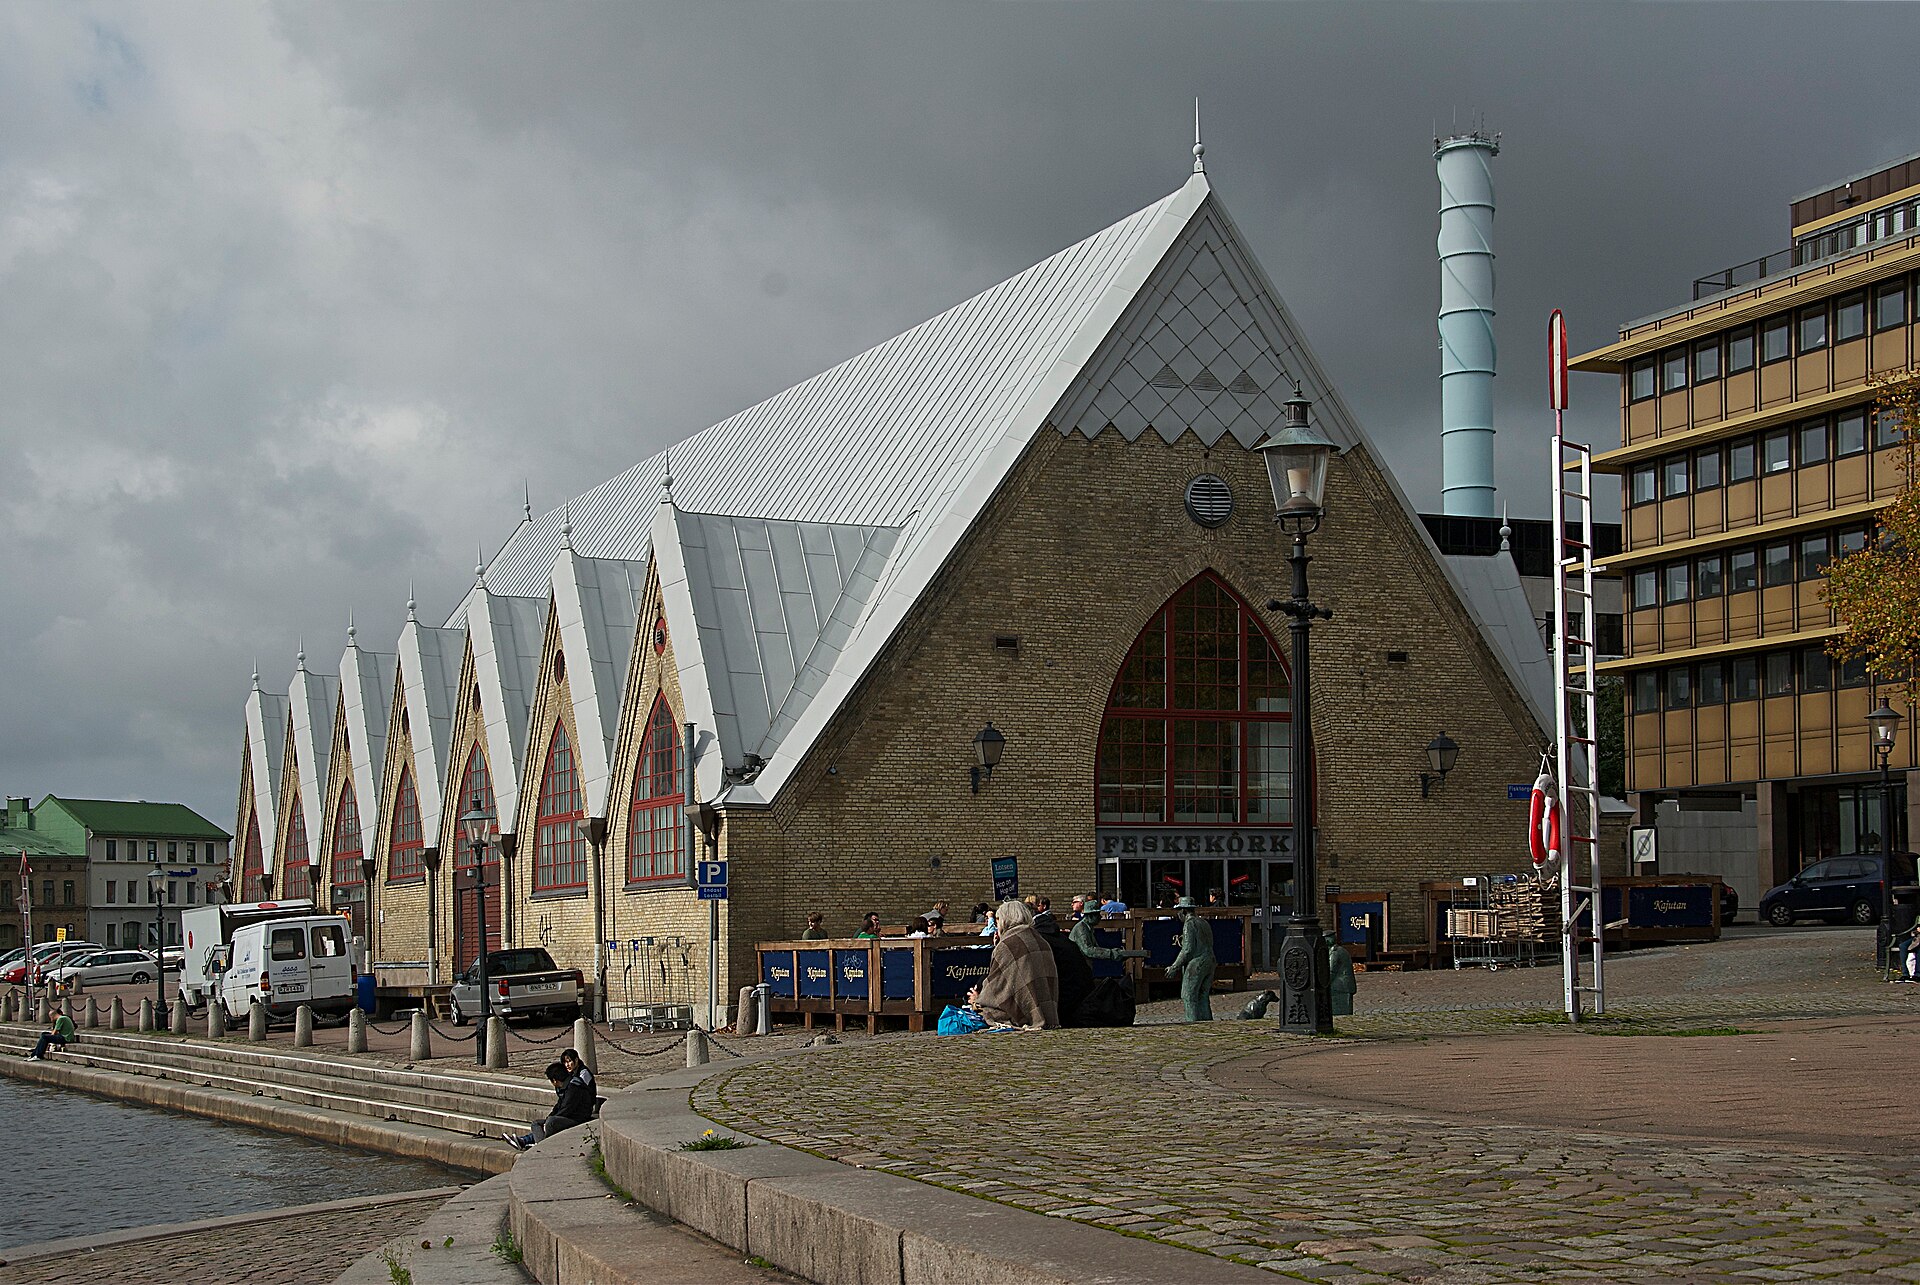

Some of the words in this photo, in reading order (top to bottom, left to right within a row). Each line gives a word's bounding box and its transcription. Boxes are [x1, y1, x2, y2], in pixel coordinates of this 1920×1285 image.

[1102, 831, 1291, 853] FESKEKÔRK
[707, 863, 721, 883] P
[1653, 900, 1687, 913] Kajutan
[1350, 916, 1365, 930] Kaju
[945, 964, 990, 981] Kajutan
